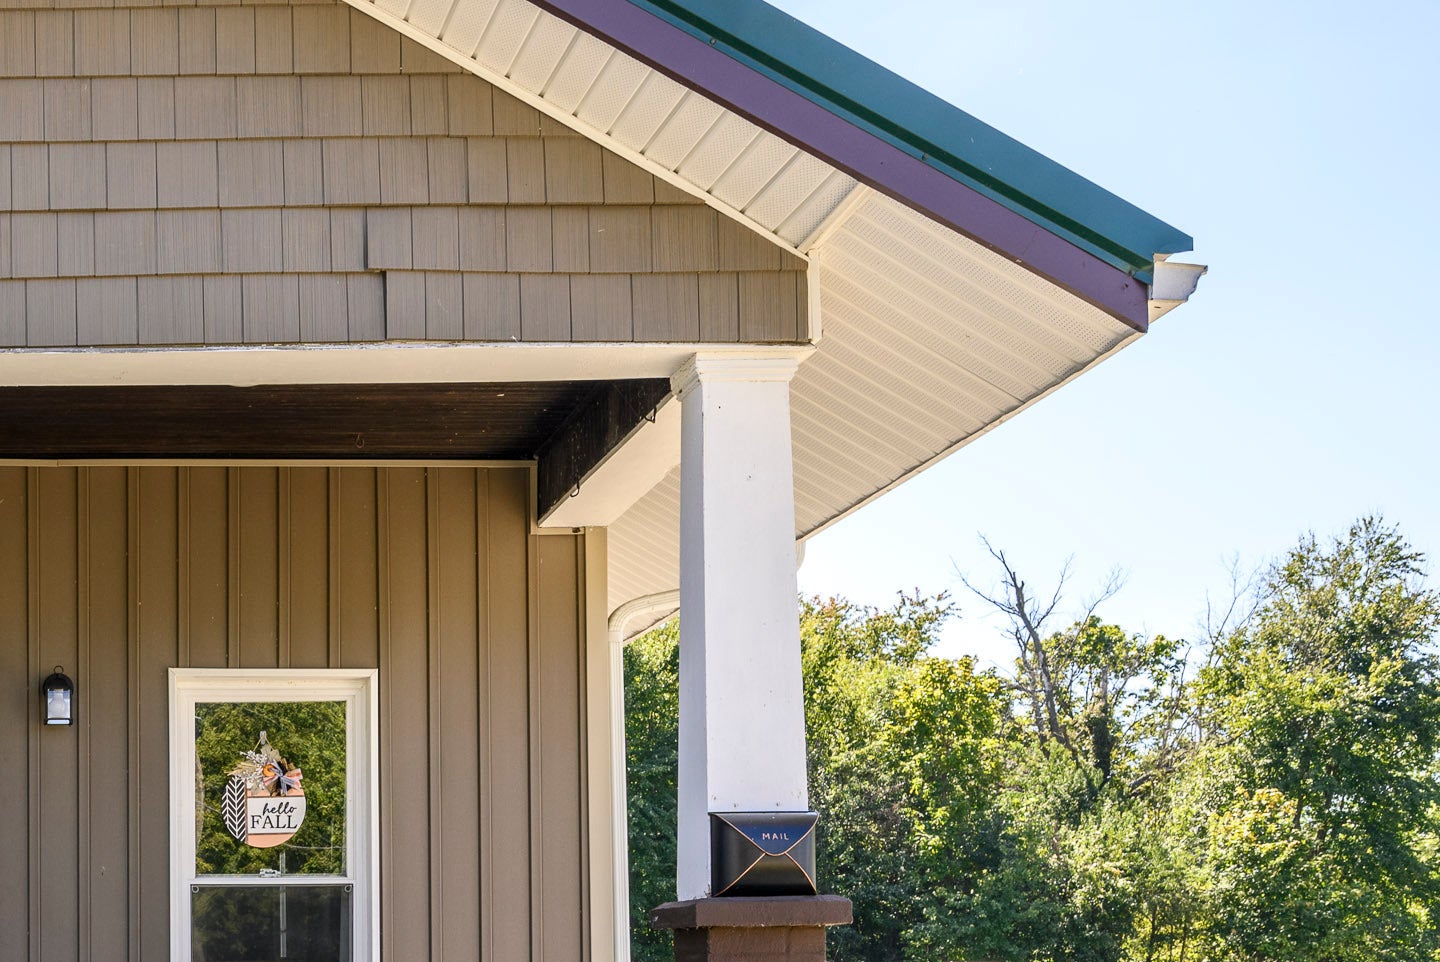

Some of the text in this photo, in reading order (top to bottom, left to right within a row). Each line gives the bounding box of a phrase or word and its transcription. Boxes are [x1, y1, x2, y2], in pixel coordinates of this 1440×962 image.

[263, 802, 297, 815] hello
[251, 815, 298, 829] FALL
[762, 833, 789, 841] MAIL
